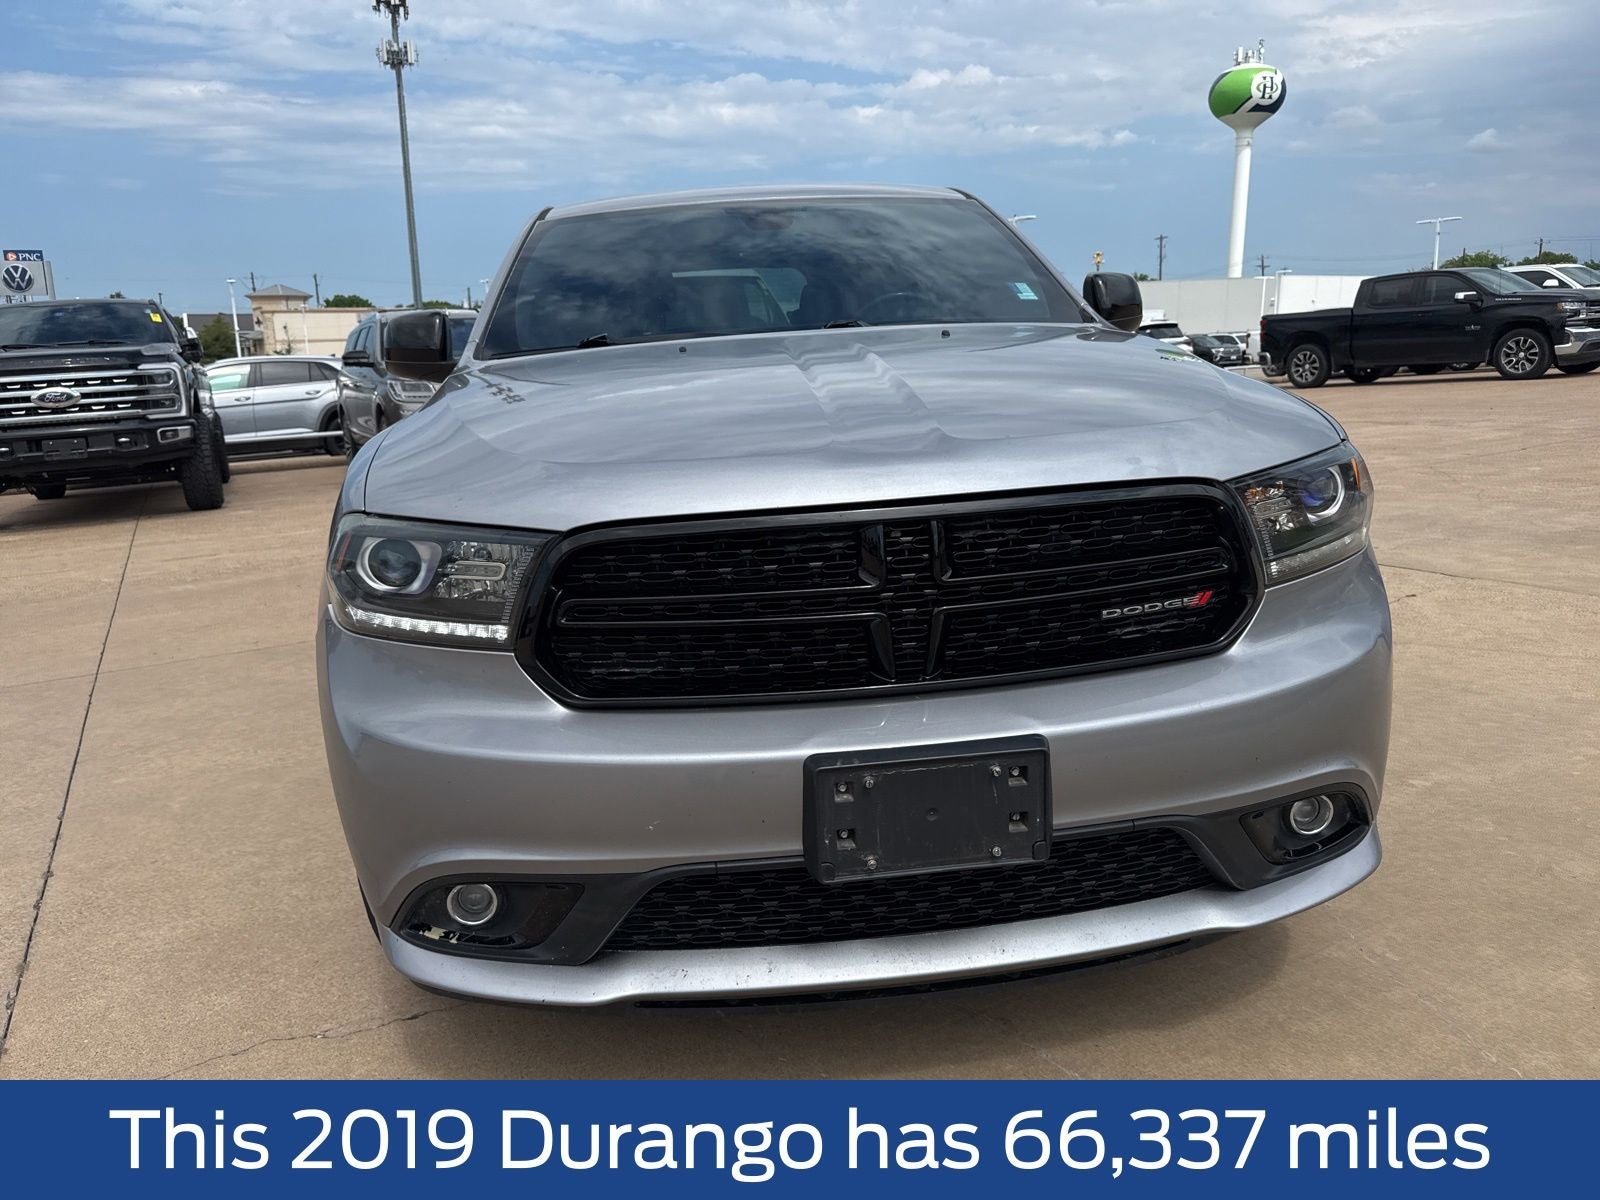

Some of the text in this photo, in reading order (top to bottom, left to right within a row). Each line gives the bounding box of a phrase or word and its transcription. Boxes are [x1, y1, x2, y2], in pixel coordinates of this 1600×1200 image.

[18, 253, 42, 261] PNC
[44, 392, 68, 403] Ford
[1102, 595, 1202, 619] DODGE
